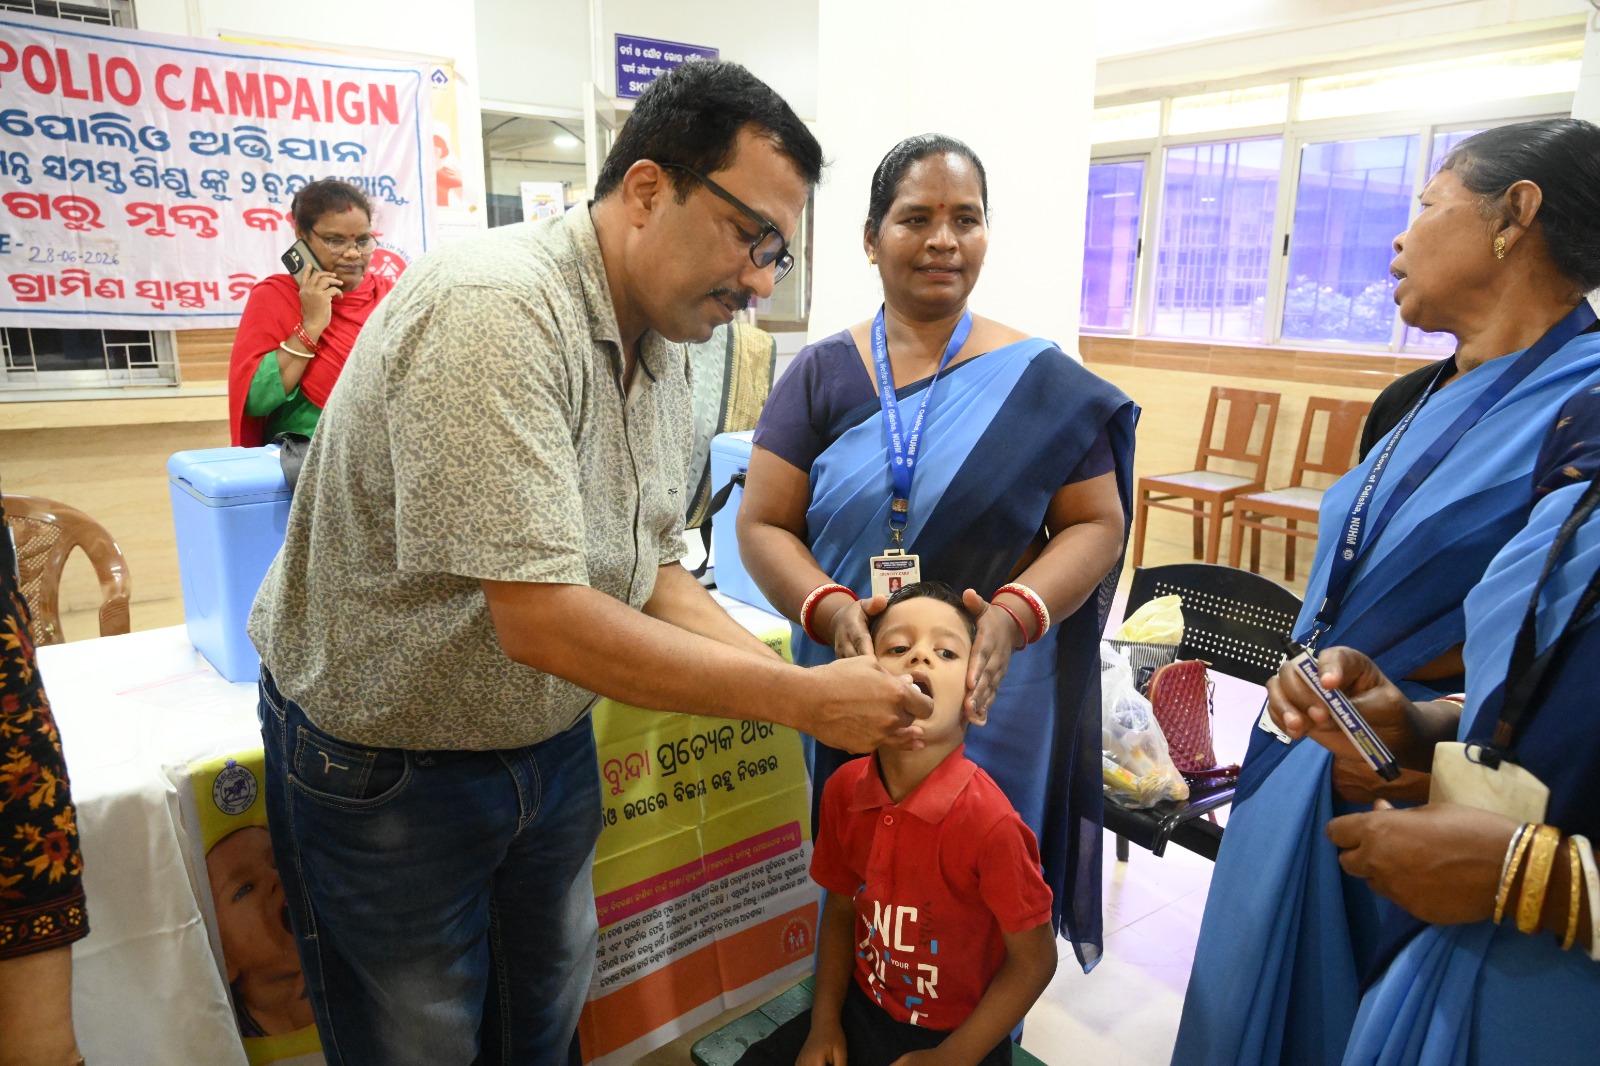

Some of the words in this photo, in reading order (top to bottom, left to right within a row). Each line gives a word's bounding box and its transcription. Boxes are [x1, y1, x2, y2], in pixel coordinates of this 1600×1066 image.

[0, 43, 141, 107] POLIO
[155, 63, 400, 126] CAMPAIGN
[0, 108, 171, 154] ପୋଲିଓ
[188, 125, 368, 163] ଅଭିଯାନ
[125, 202, 219, 238] ମୁକ୍ତ
[28, 246, 120, 265] 28-06-2026
[1373, 452, 1389, 472] Govt.
[1352, 485, 1372, 515] Odisha,
[1346, 517, 1361, 545] NUHM
[1330, 698, 1356, 730] Marker
[891, 958, 909, 970] YOUR
